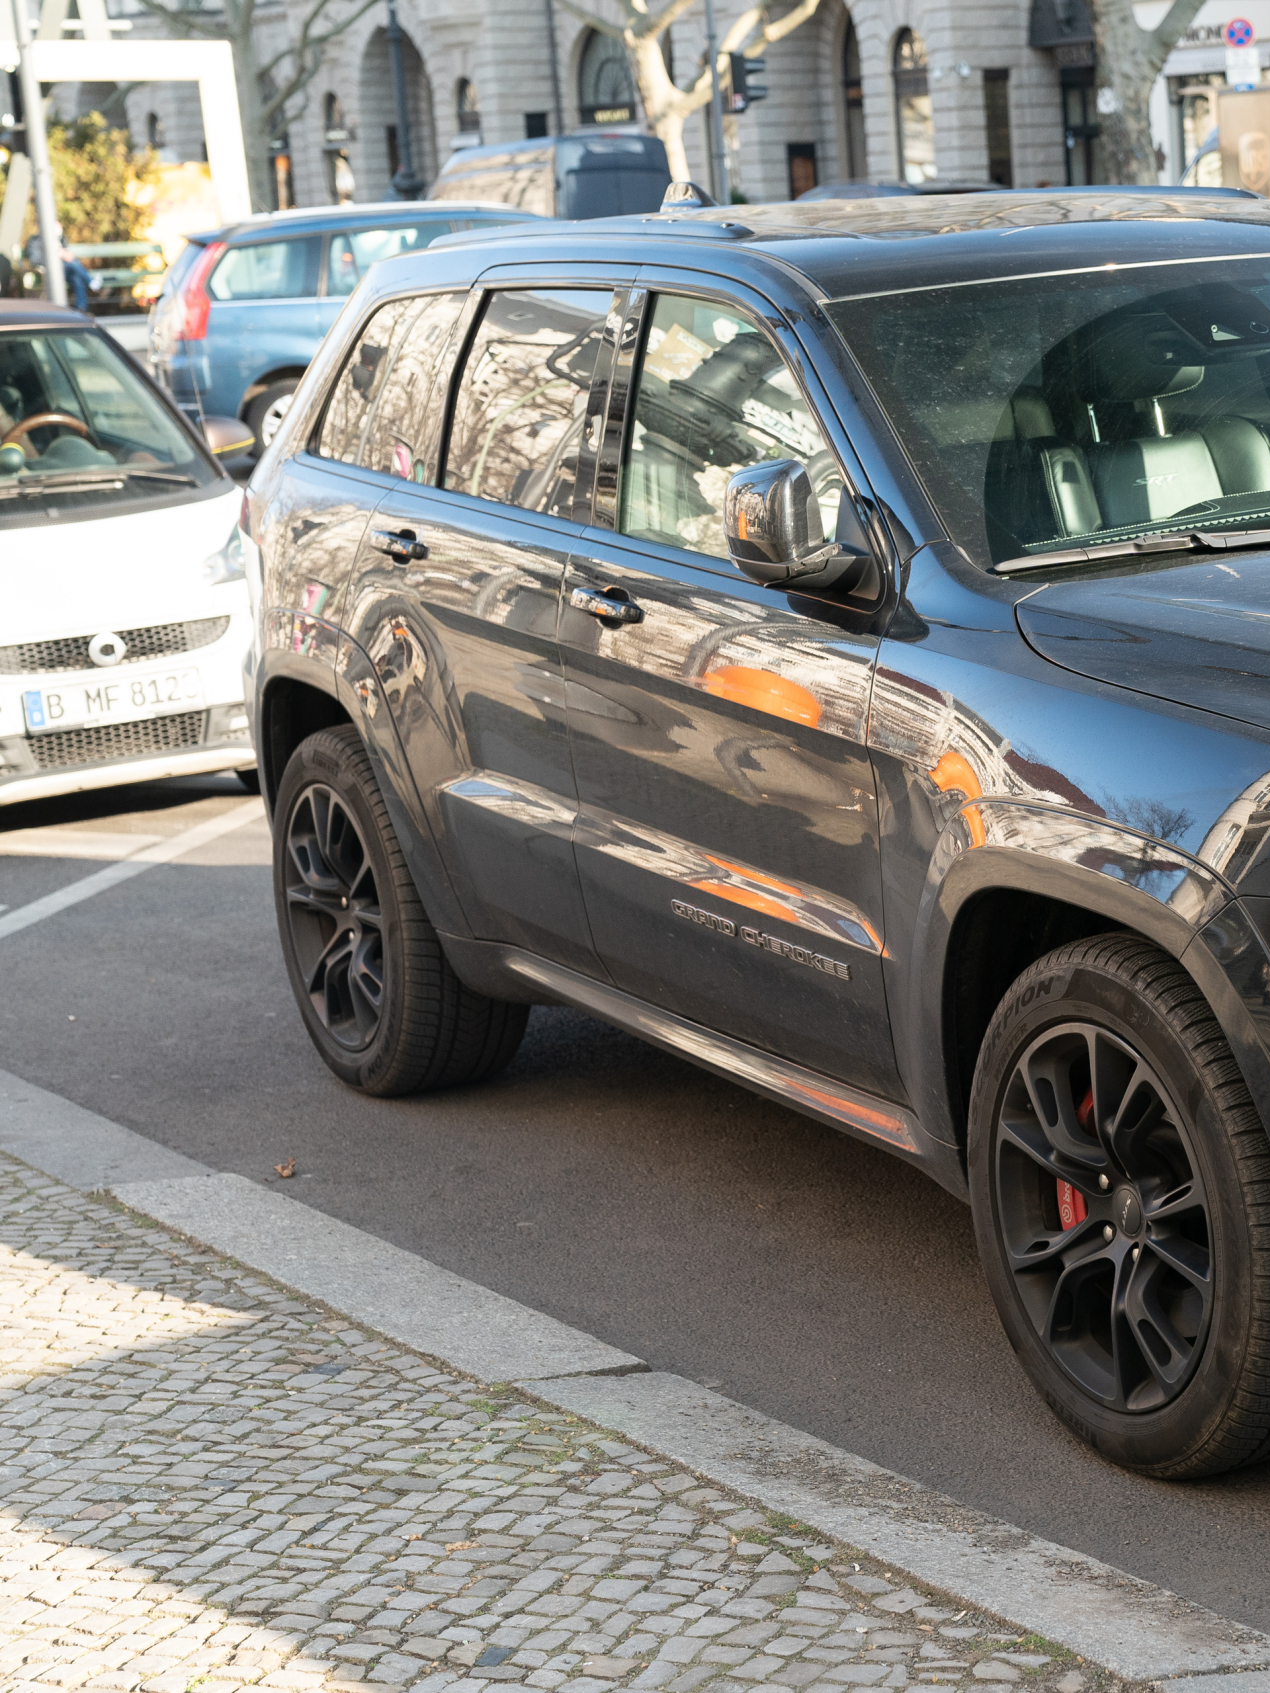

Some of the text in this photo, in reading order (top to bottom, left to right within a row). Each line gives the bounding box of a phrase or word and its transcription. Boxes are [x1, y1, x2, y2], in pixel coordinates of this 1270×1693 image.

[46, 693, 65, 720] B
[84, 684, 120, 714] MF
[671, 898, 851, 981] GRAND CHEROKEE
